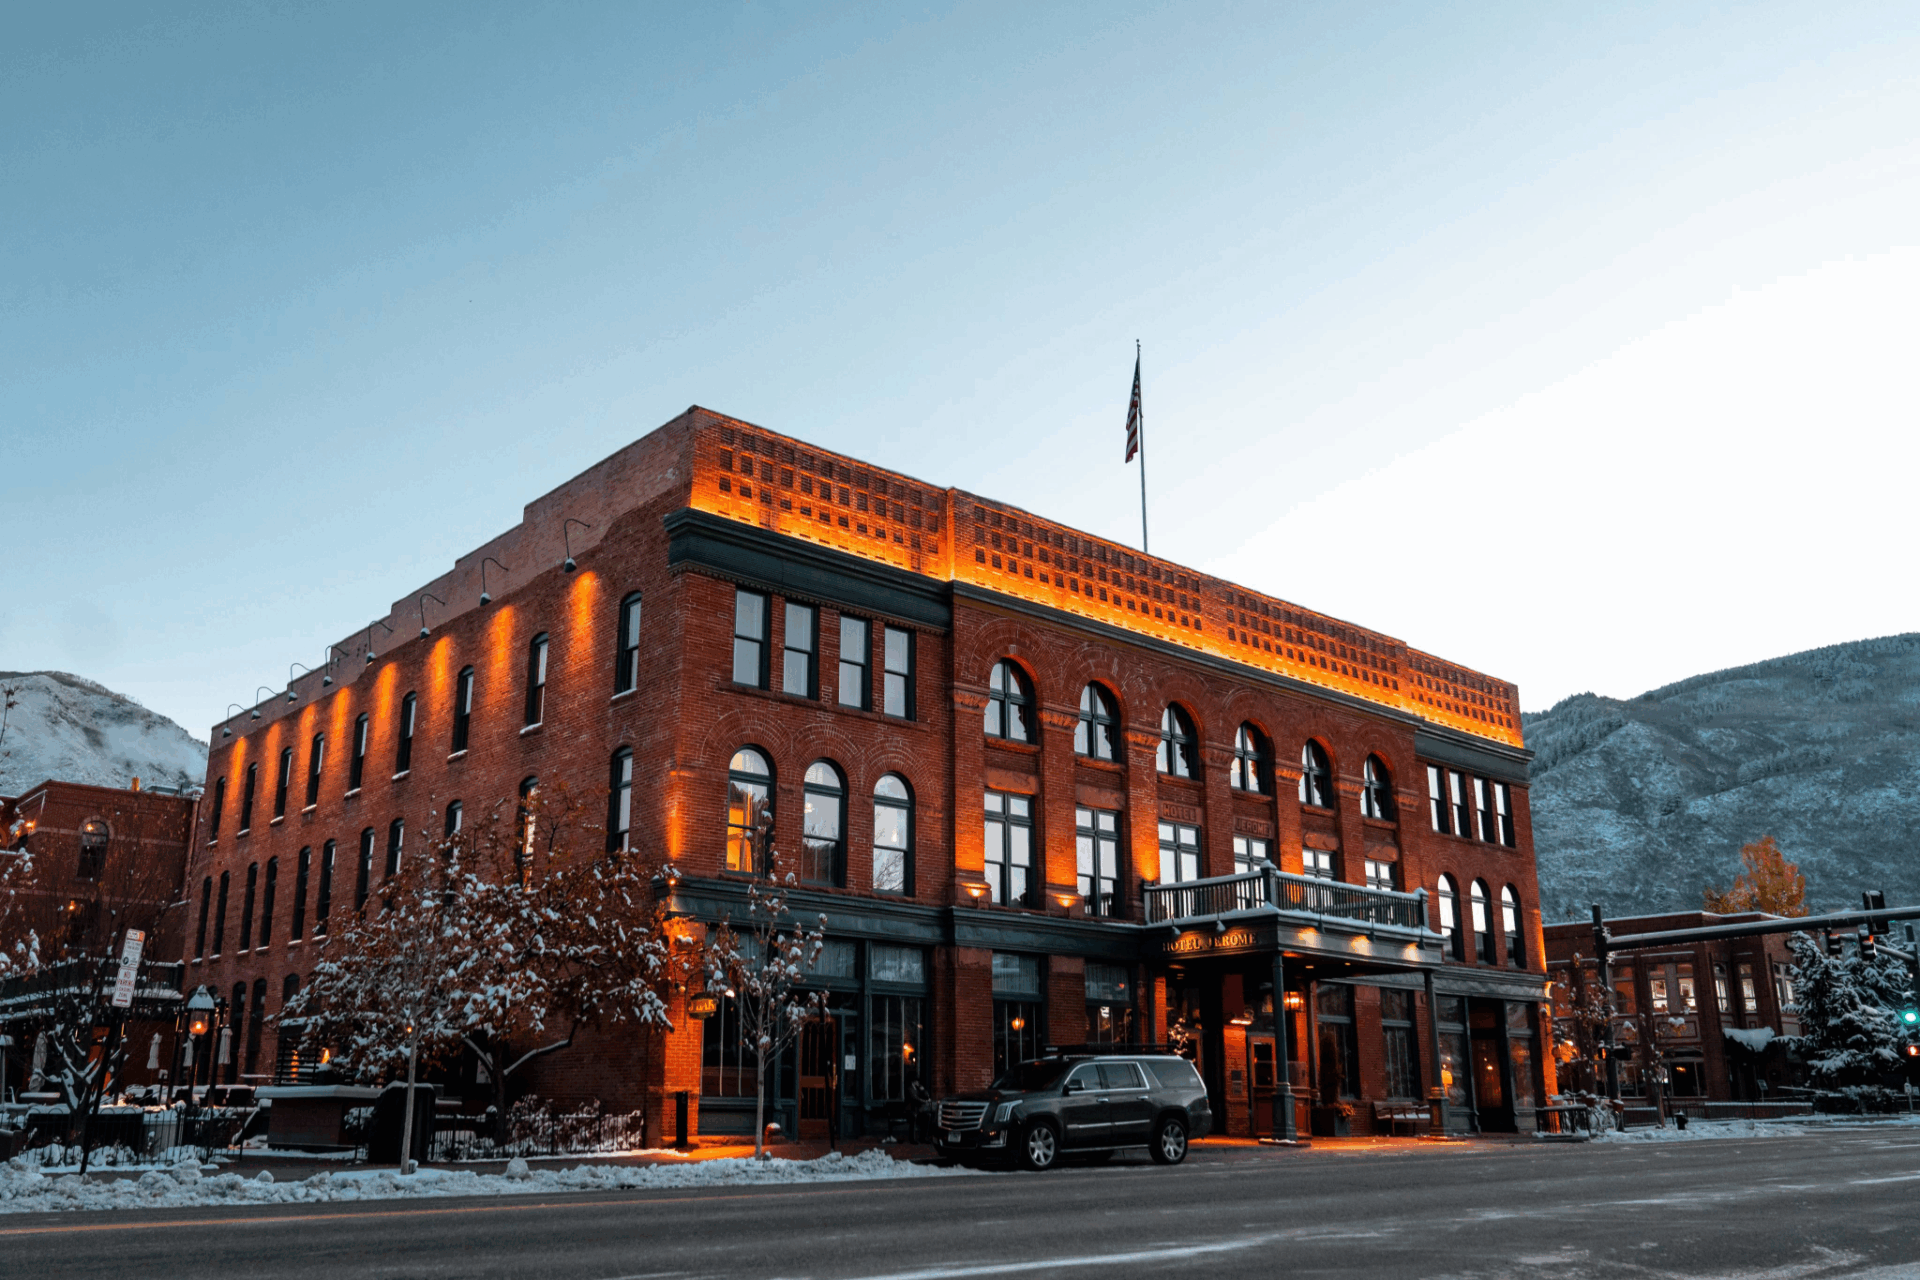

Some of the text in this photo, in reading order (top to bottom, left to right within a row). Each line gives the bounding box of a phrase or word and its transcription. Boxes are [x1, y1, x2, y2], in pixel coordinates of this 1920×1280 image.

[1163, 802, 1270, 836] HOTEL JEROME
[1162, 932, 1256, 952] HOTEL JEROME
